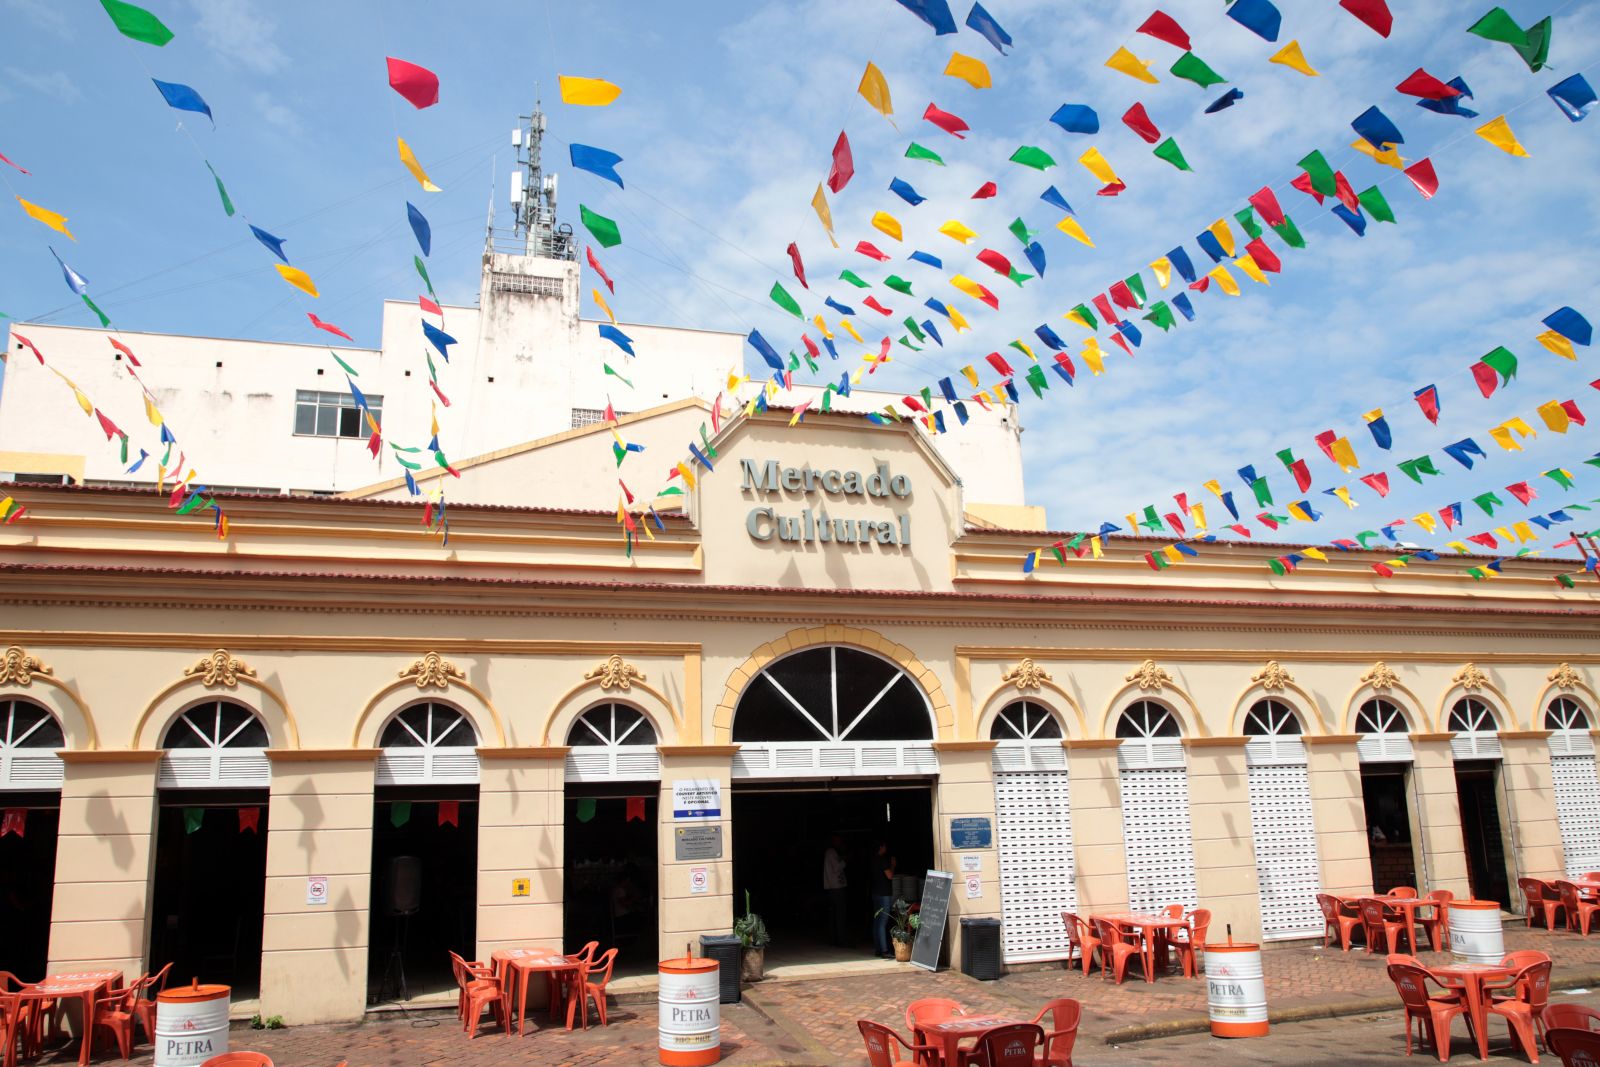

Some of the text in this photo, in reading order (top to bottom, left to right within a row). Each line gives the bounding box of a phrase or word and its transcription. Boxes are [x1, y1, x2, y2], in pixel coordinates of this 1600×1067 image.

[740, 458, 912, 498] Mercado
[746, 506, 911, 545] Cultural
[1209, 981, 1244, 996] PETRA
[1400, 982, 1417, 992] PETRA
[672, 1007, 711, 1022] PETRA
[167, 1039, 213, 1056] PETRA
[1004, 1047, 1026, 1057] PETRA
